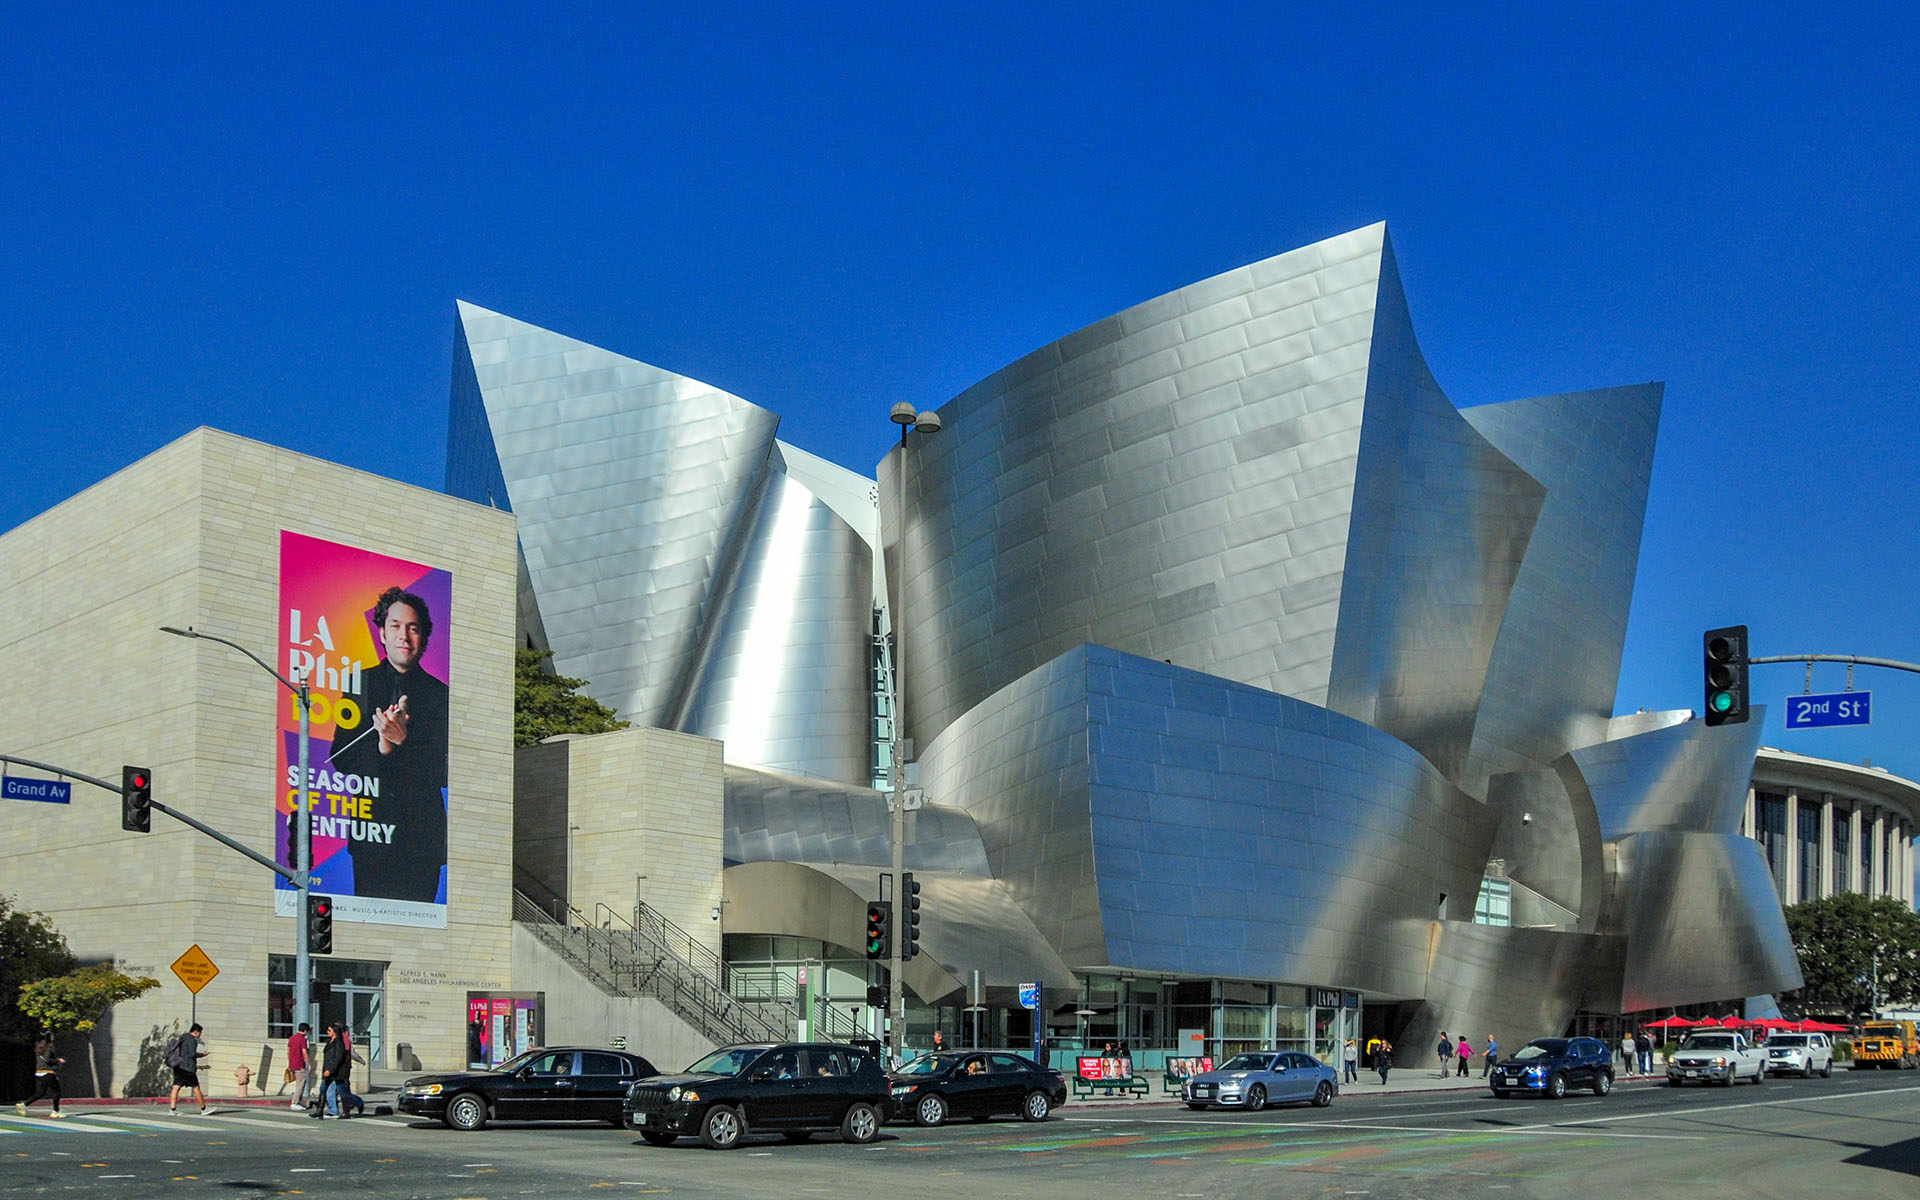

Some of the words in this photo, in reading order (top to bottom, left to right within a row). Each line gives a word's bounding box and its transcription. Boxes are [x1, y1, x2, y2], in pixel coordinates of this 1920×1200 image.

[290, 608, 335, 651] LA
[289, 648, 361, 695] Phil
[290, 692, 361, 730] 100
[1796, 700, 1830, 722] 2nd
[1838, 700, 1860, 718] St
[7, 781, 46, 796] Grand
[49, 785, 66, 797] Av
[287, 765, 380, 798] SEASON
[286, 789, 321, 812] OF
[326, 793, 373, 820] THE
[286, 813, 396, 844] ENTURY
